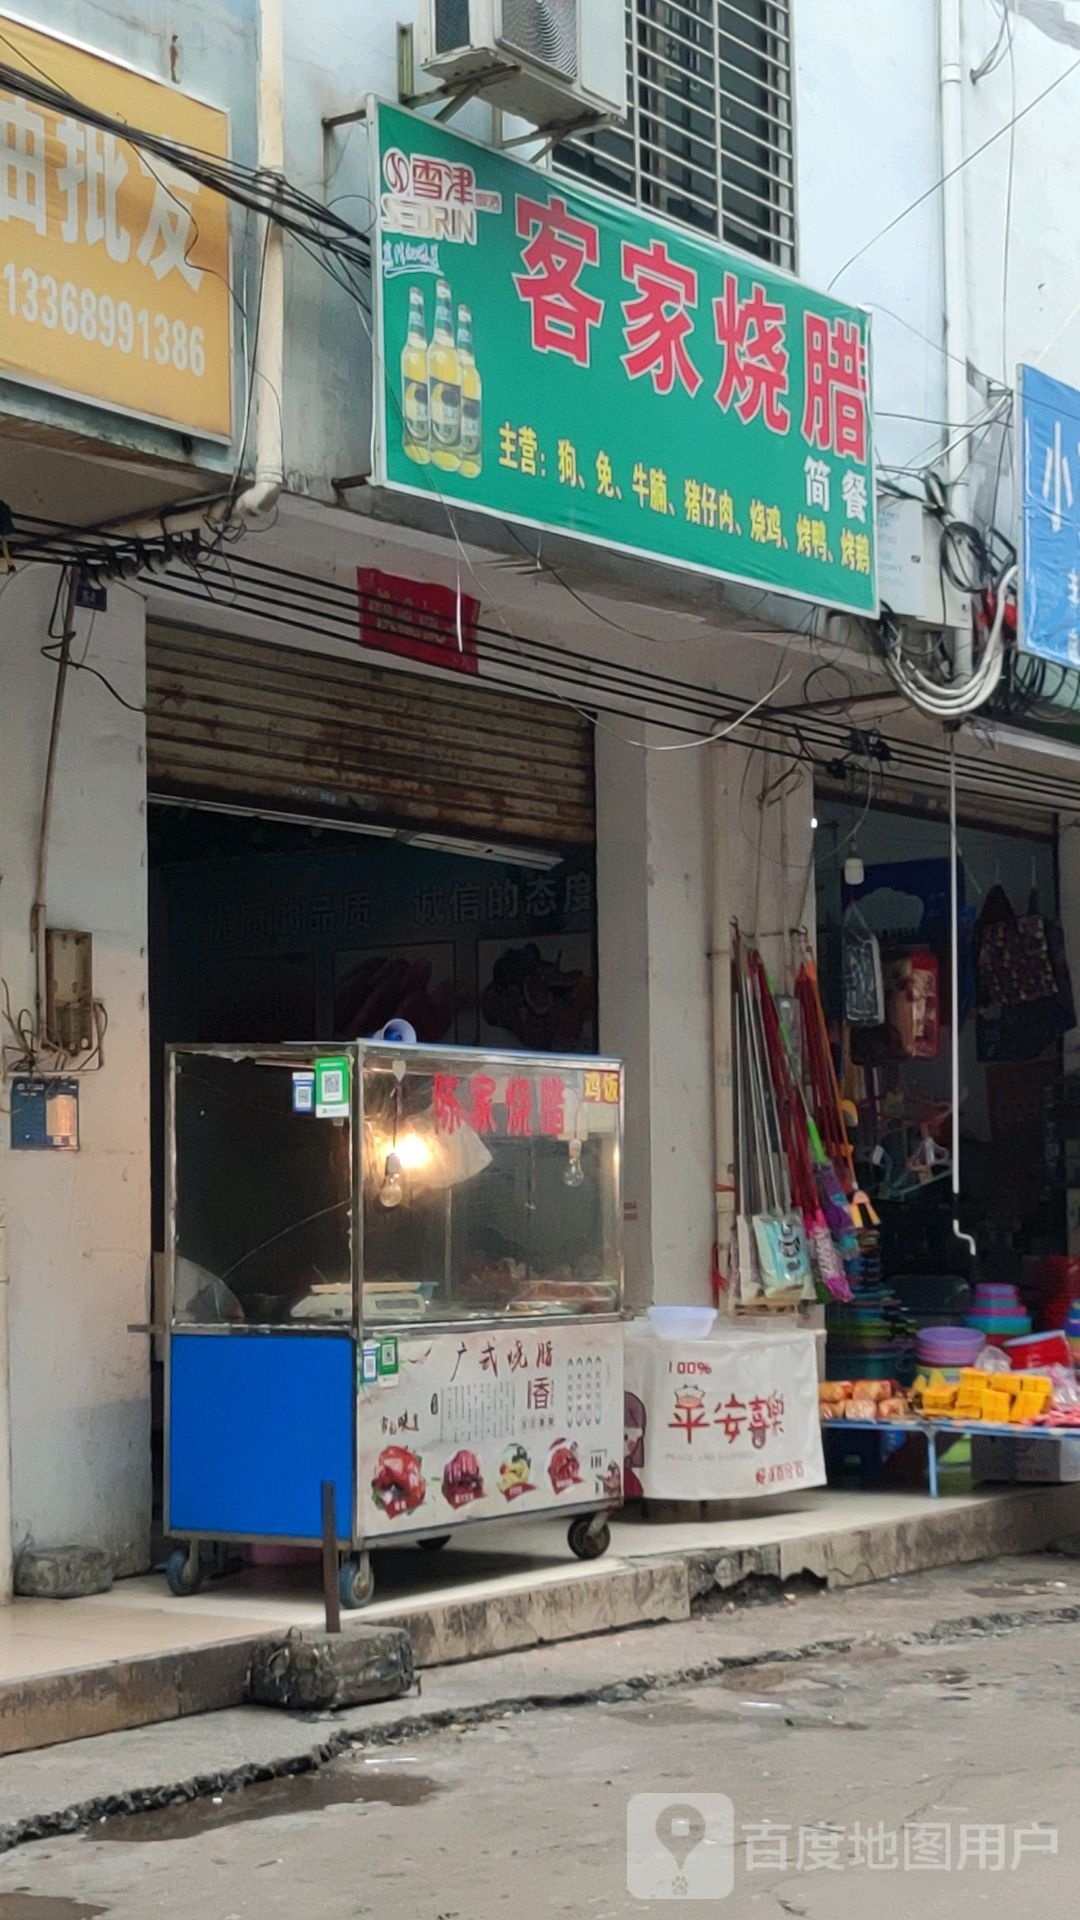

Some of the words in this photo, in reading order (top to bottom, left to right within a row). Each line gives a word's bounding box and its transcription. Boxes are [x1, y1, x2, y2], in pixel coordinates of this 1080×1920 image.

[411, 157, 474, 203] 雪津
[383, 198, 476, 244] SEDRIN
[4, 262, 205, 376] 13368991386
[512, 193, 867, 464] 客家烧腊
[804, 455, 867, 524] 简餐
[415, 870, 591, 925] 诚信的态度
